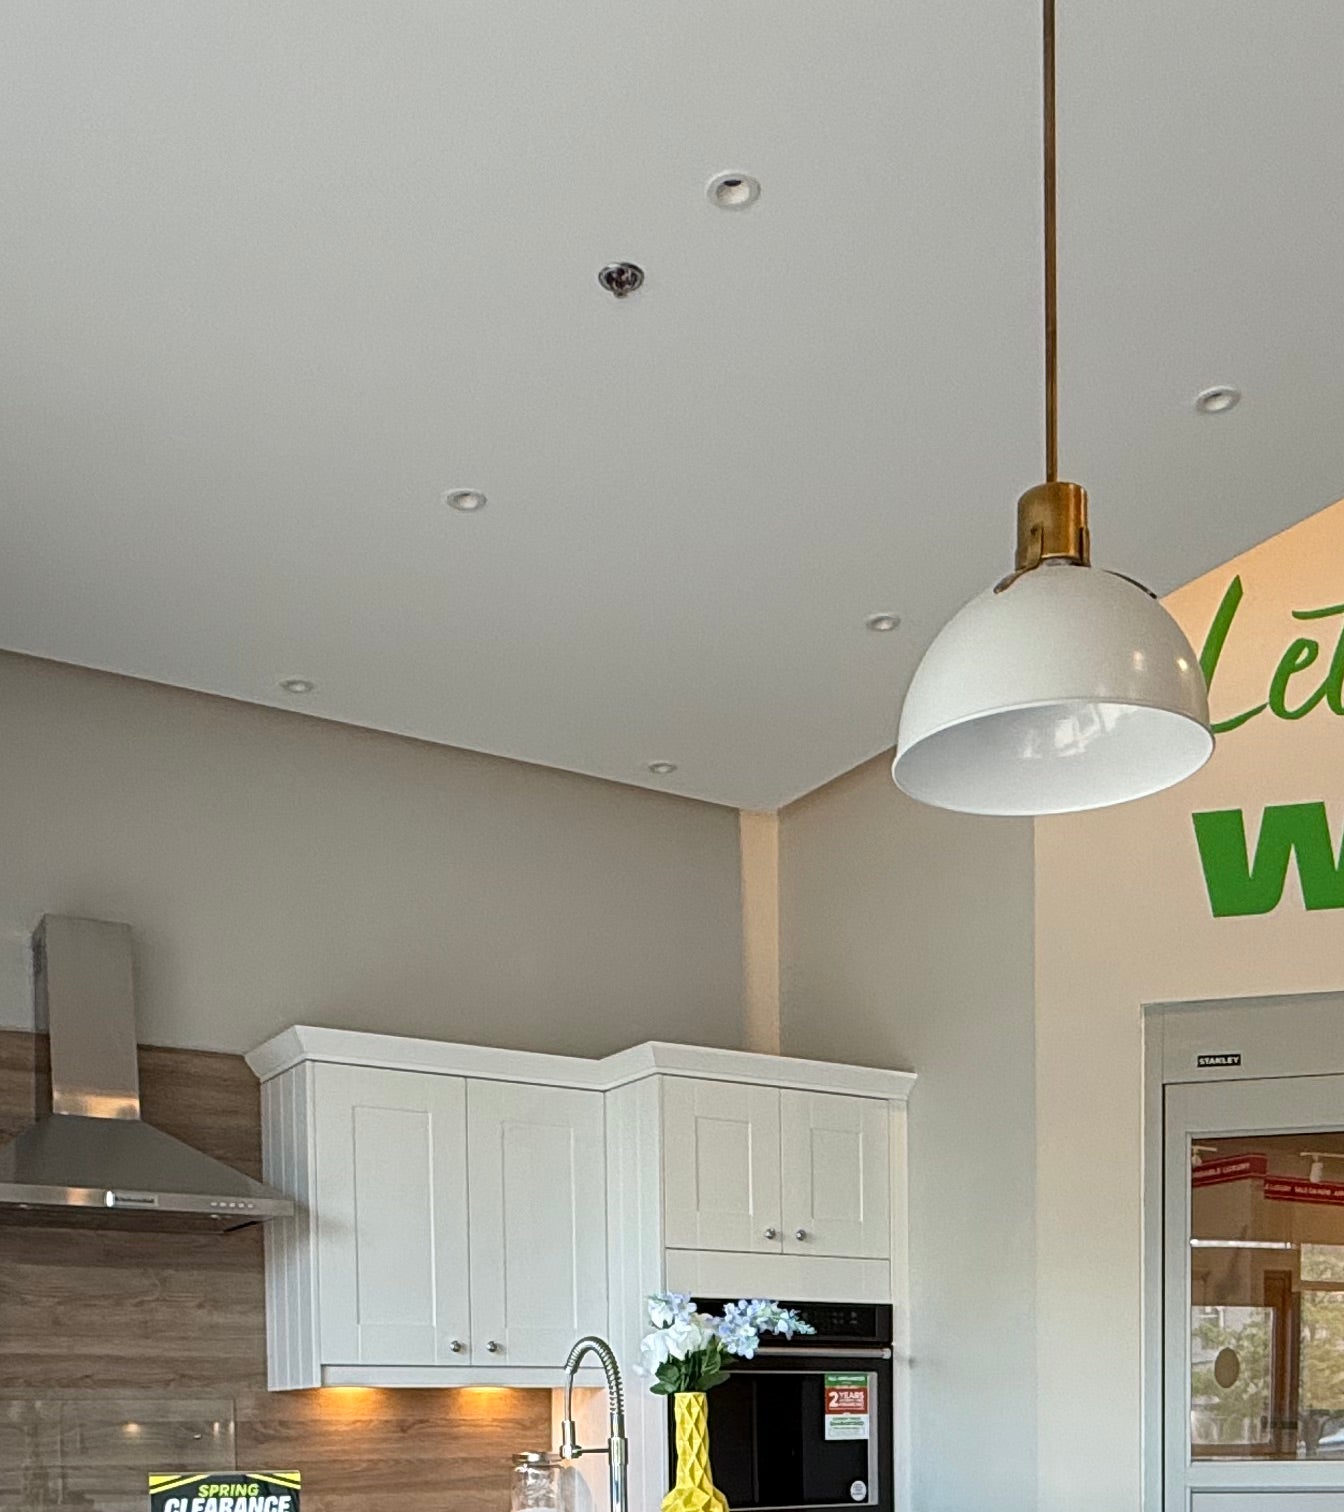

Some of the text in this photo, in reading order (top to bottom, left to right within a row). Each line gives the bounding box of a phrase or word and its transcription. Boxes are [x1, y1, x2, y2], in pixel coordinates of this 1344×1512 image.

[1199, 1056, 1239, 1066] STANLEY
[828, 1391, 839, 1408] 2
[198, 1484, 259, 1498] SPRING
